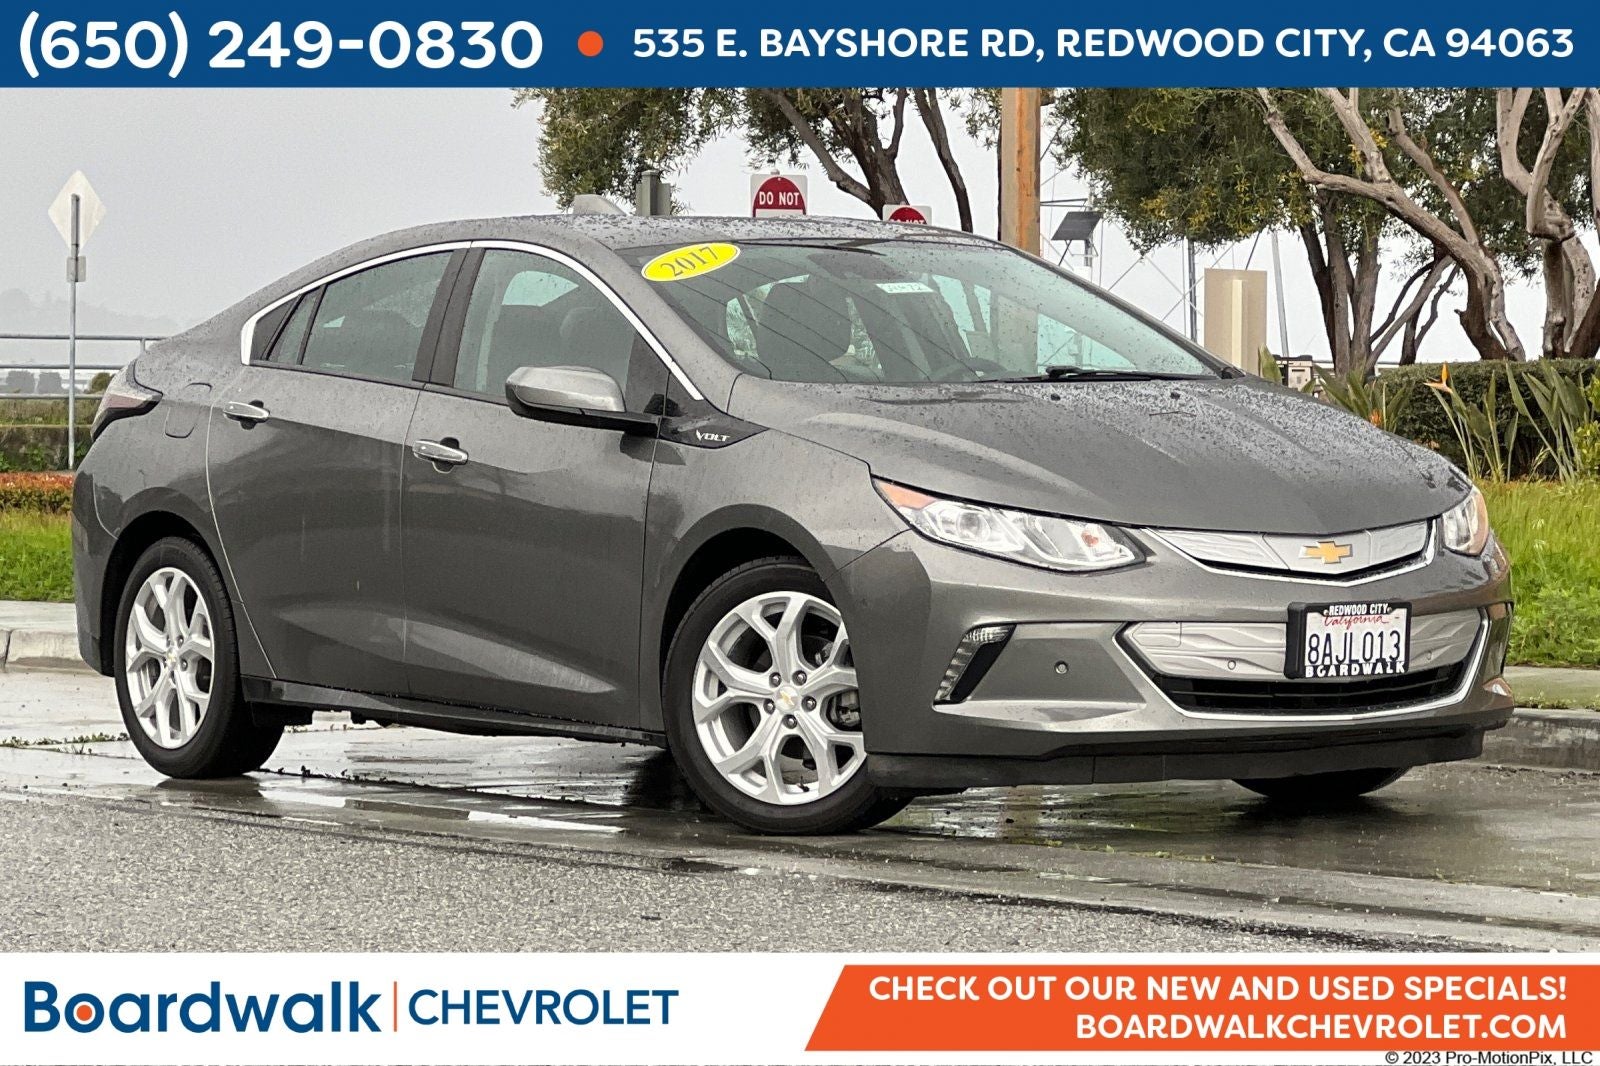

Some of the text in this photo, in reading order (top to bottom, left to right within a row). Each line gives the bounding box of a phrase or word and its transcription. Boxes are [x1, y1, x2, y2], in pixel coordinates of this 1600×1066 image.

[759, 191, 799, 206] DO NOT
[660, 246, 719, 277] 2017
[695, 429, 731, 442] VOLT
[1328, 603, 1389, 616] REDWOOD CITY
[1307, 630, 1401, 665] 8AJL013
